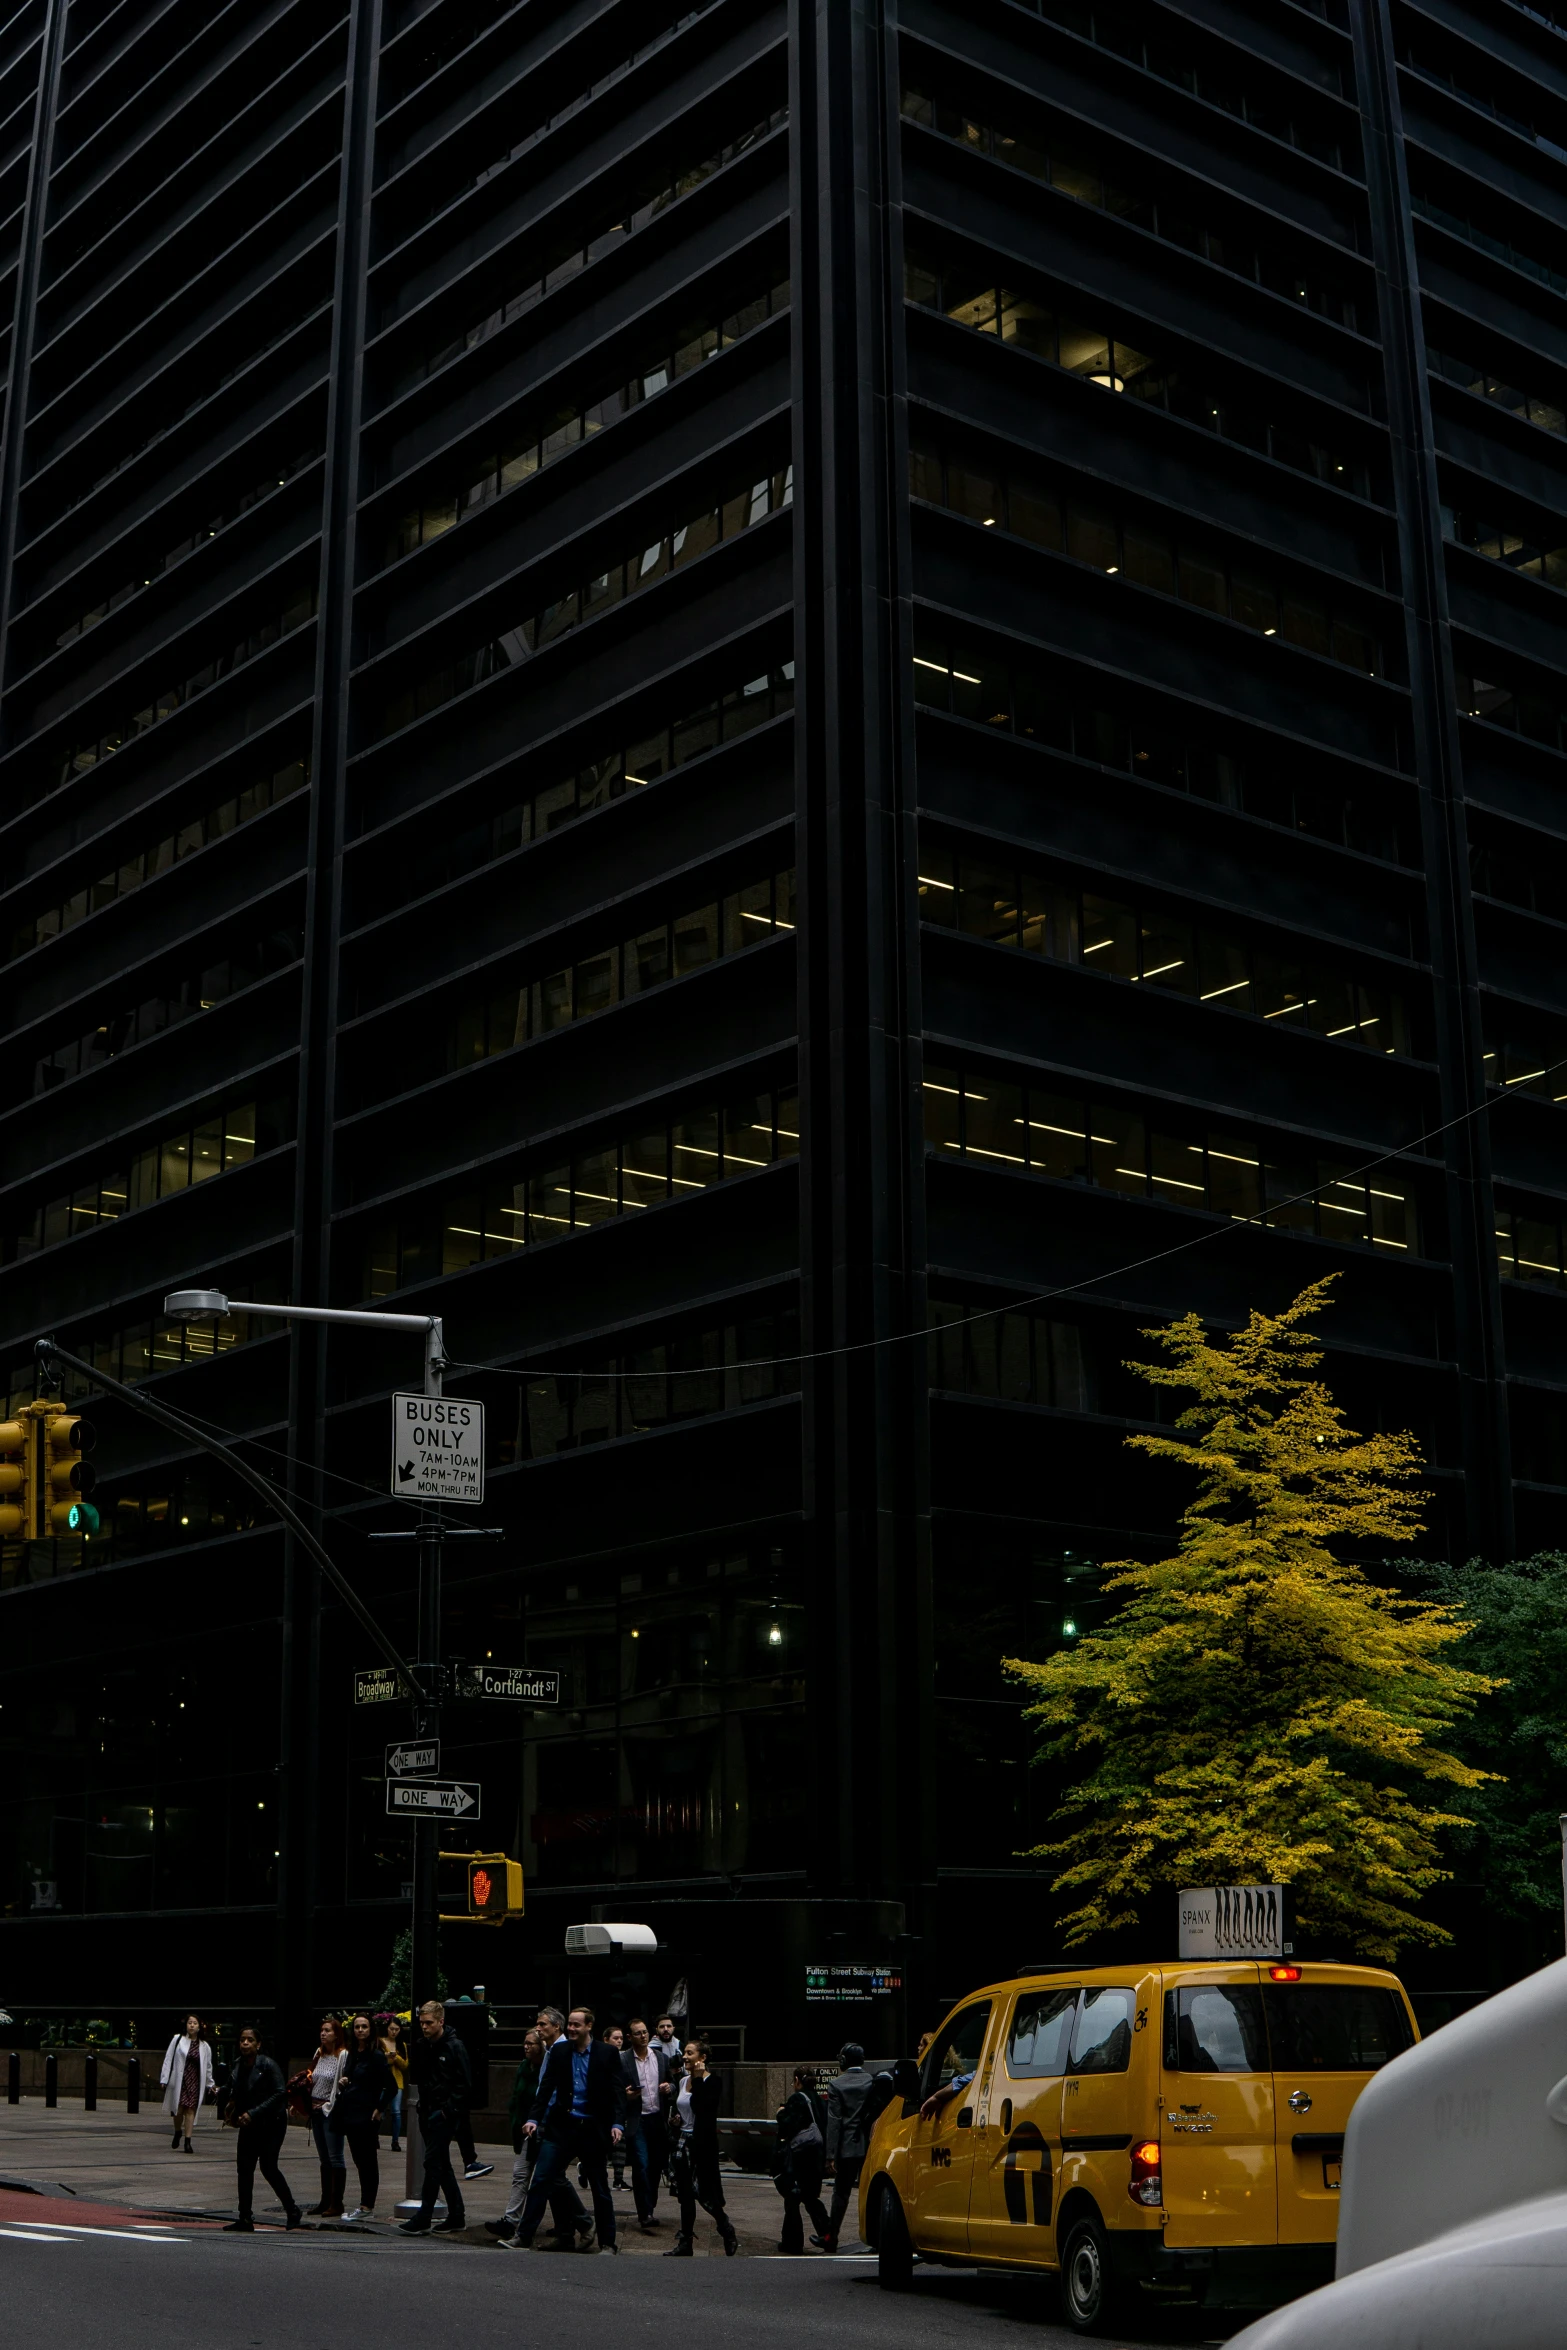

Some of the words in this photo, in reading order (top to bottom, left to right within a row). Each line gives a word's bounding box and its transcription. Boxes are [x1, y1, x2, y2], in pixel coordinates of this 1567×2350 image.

[407, 1402, 471, 1426] BUSES
[413, 1427, 464, 1449] ONLY
[419, 1451, 478, 1467] 7AM-10AM
[422, 1467, 476, 1483] 4PM-7PM
[418, 1482, 438, 1493] MON
[441, 1485, 461, 1494] THRU
[464, 1486, 478, 1496] FRI
[358, 1680, 395, 1697] Broadway
[485, 1677, 544, 1697] Cortlandt
[546, 1682, 556, 1692] ST
[394, 1754, 409, 1768] ONE
[416, 1751, 432, 1765] WAY
[402, 1790, 428, 1805] ONE
[440, 1793, 466, 1807] WAY
[1183, 1910, 1210, 1925] SPANX
[853, 1968, 874, 1977] Subway
[1174, 2124, 1213, 2133] NV200
[931, 2147, 951, 2167] NYC
